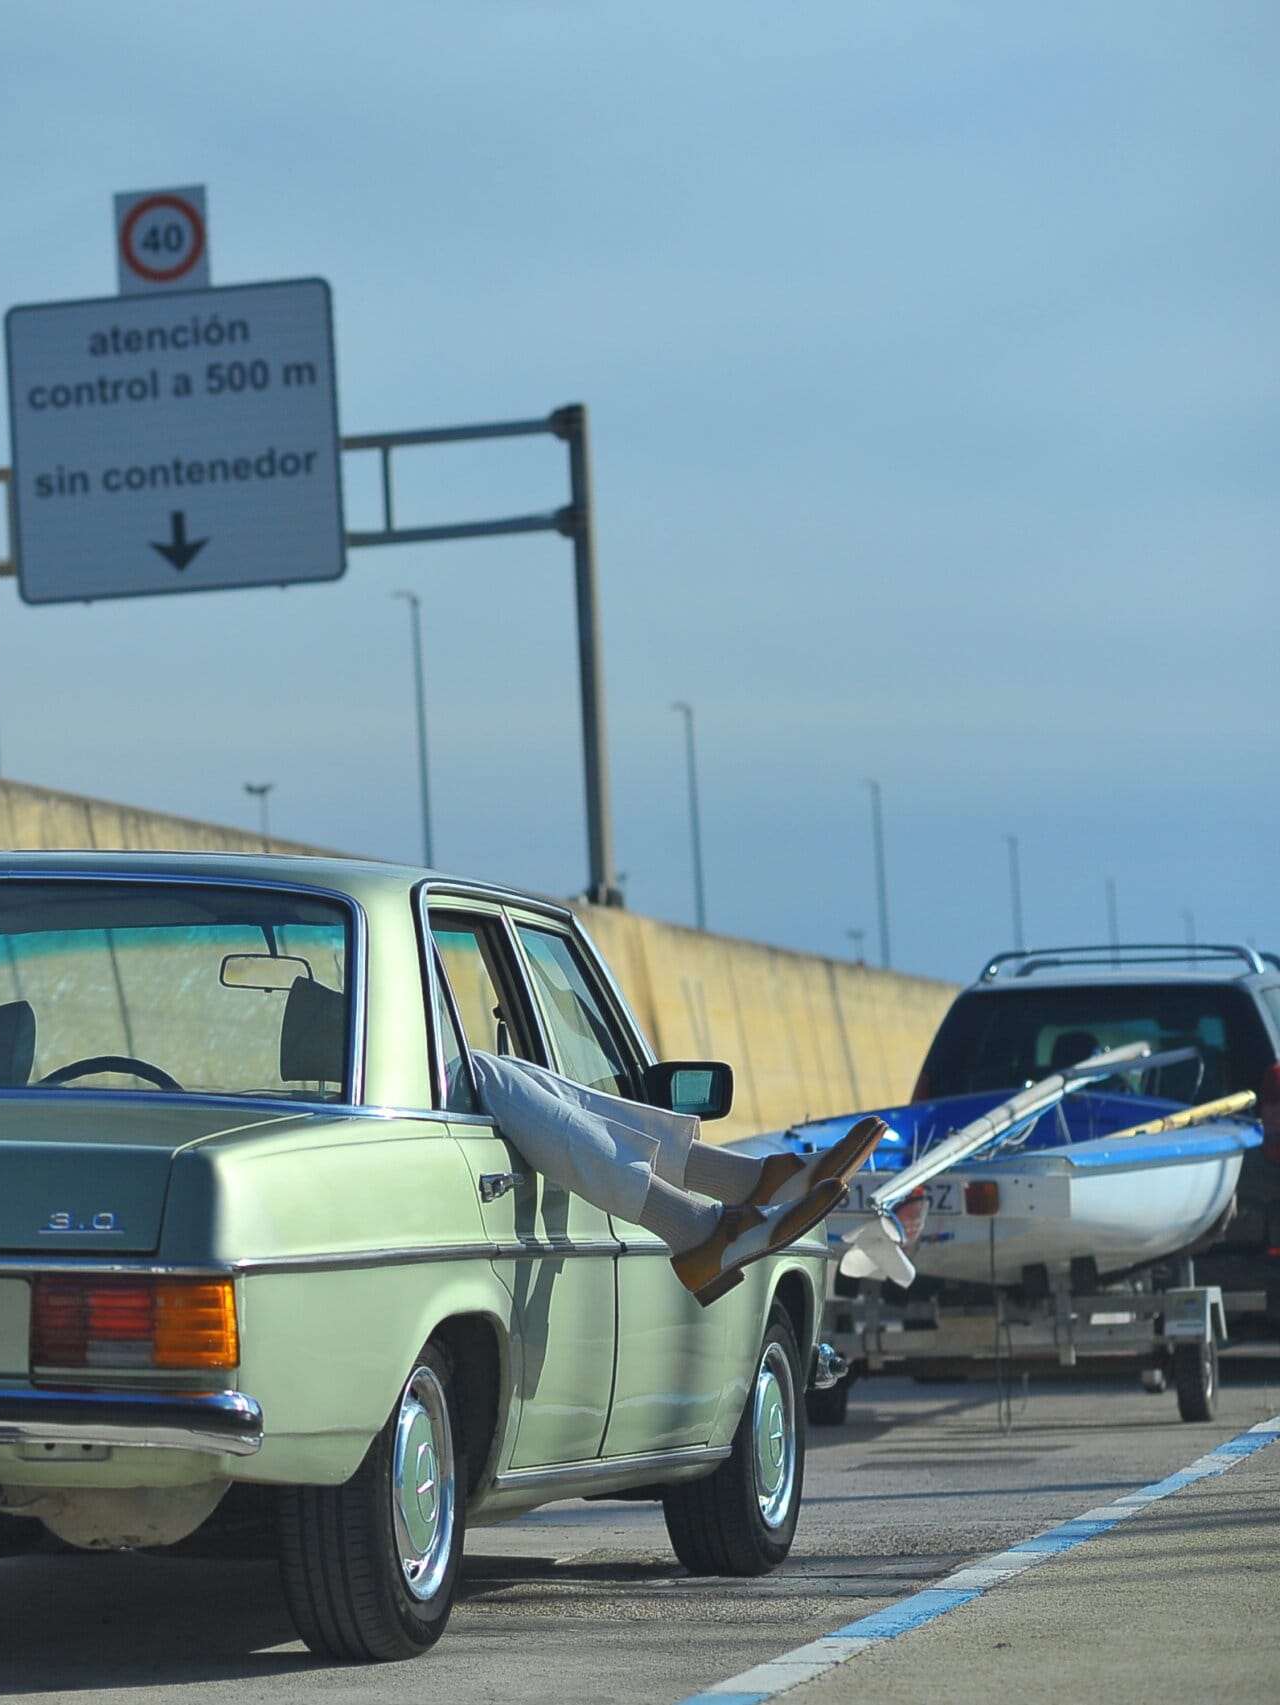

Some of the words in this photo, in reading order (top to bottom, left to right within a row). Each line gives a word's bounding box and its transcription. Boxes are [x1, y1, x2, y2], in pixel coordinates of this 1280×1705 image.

[141, 224, 185, 254] 40
[89, 315, 250, 357] atención
[28, 370, 158, 410] control
[172, 375, 192, 397] a
[206, 359, 270, 393] 500
[282, 361, 316, 388] m
[35, 464, 89, 498] sin
[102, 447, 318, 493] contenedor
[49, 1212, 115, 1229] 3.0
